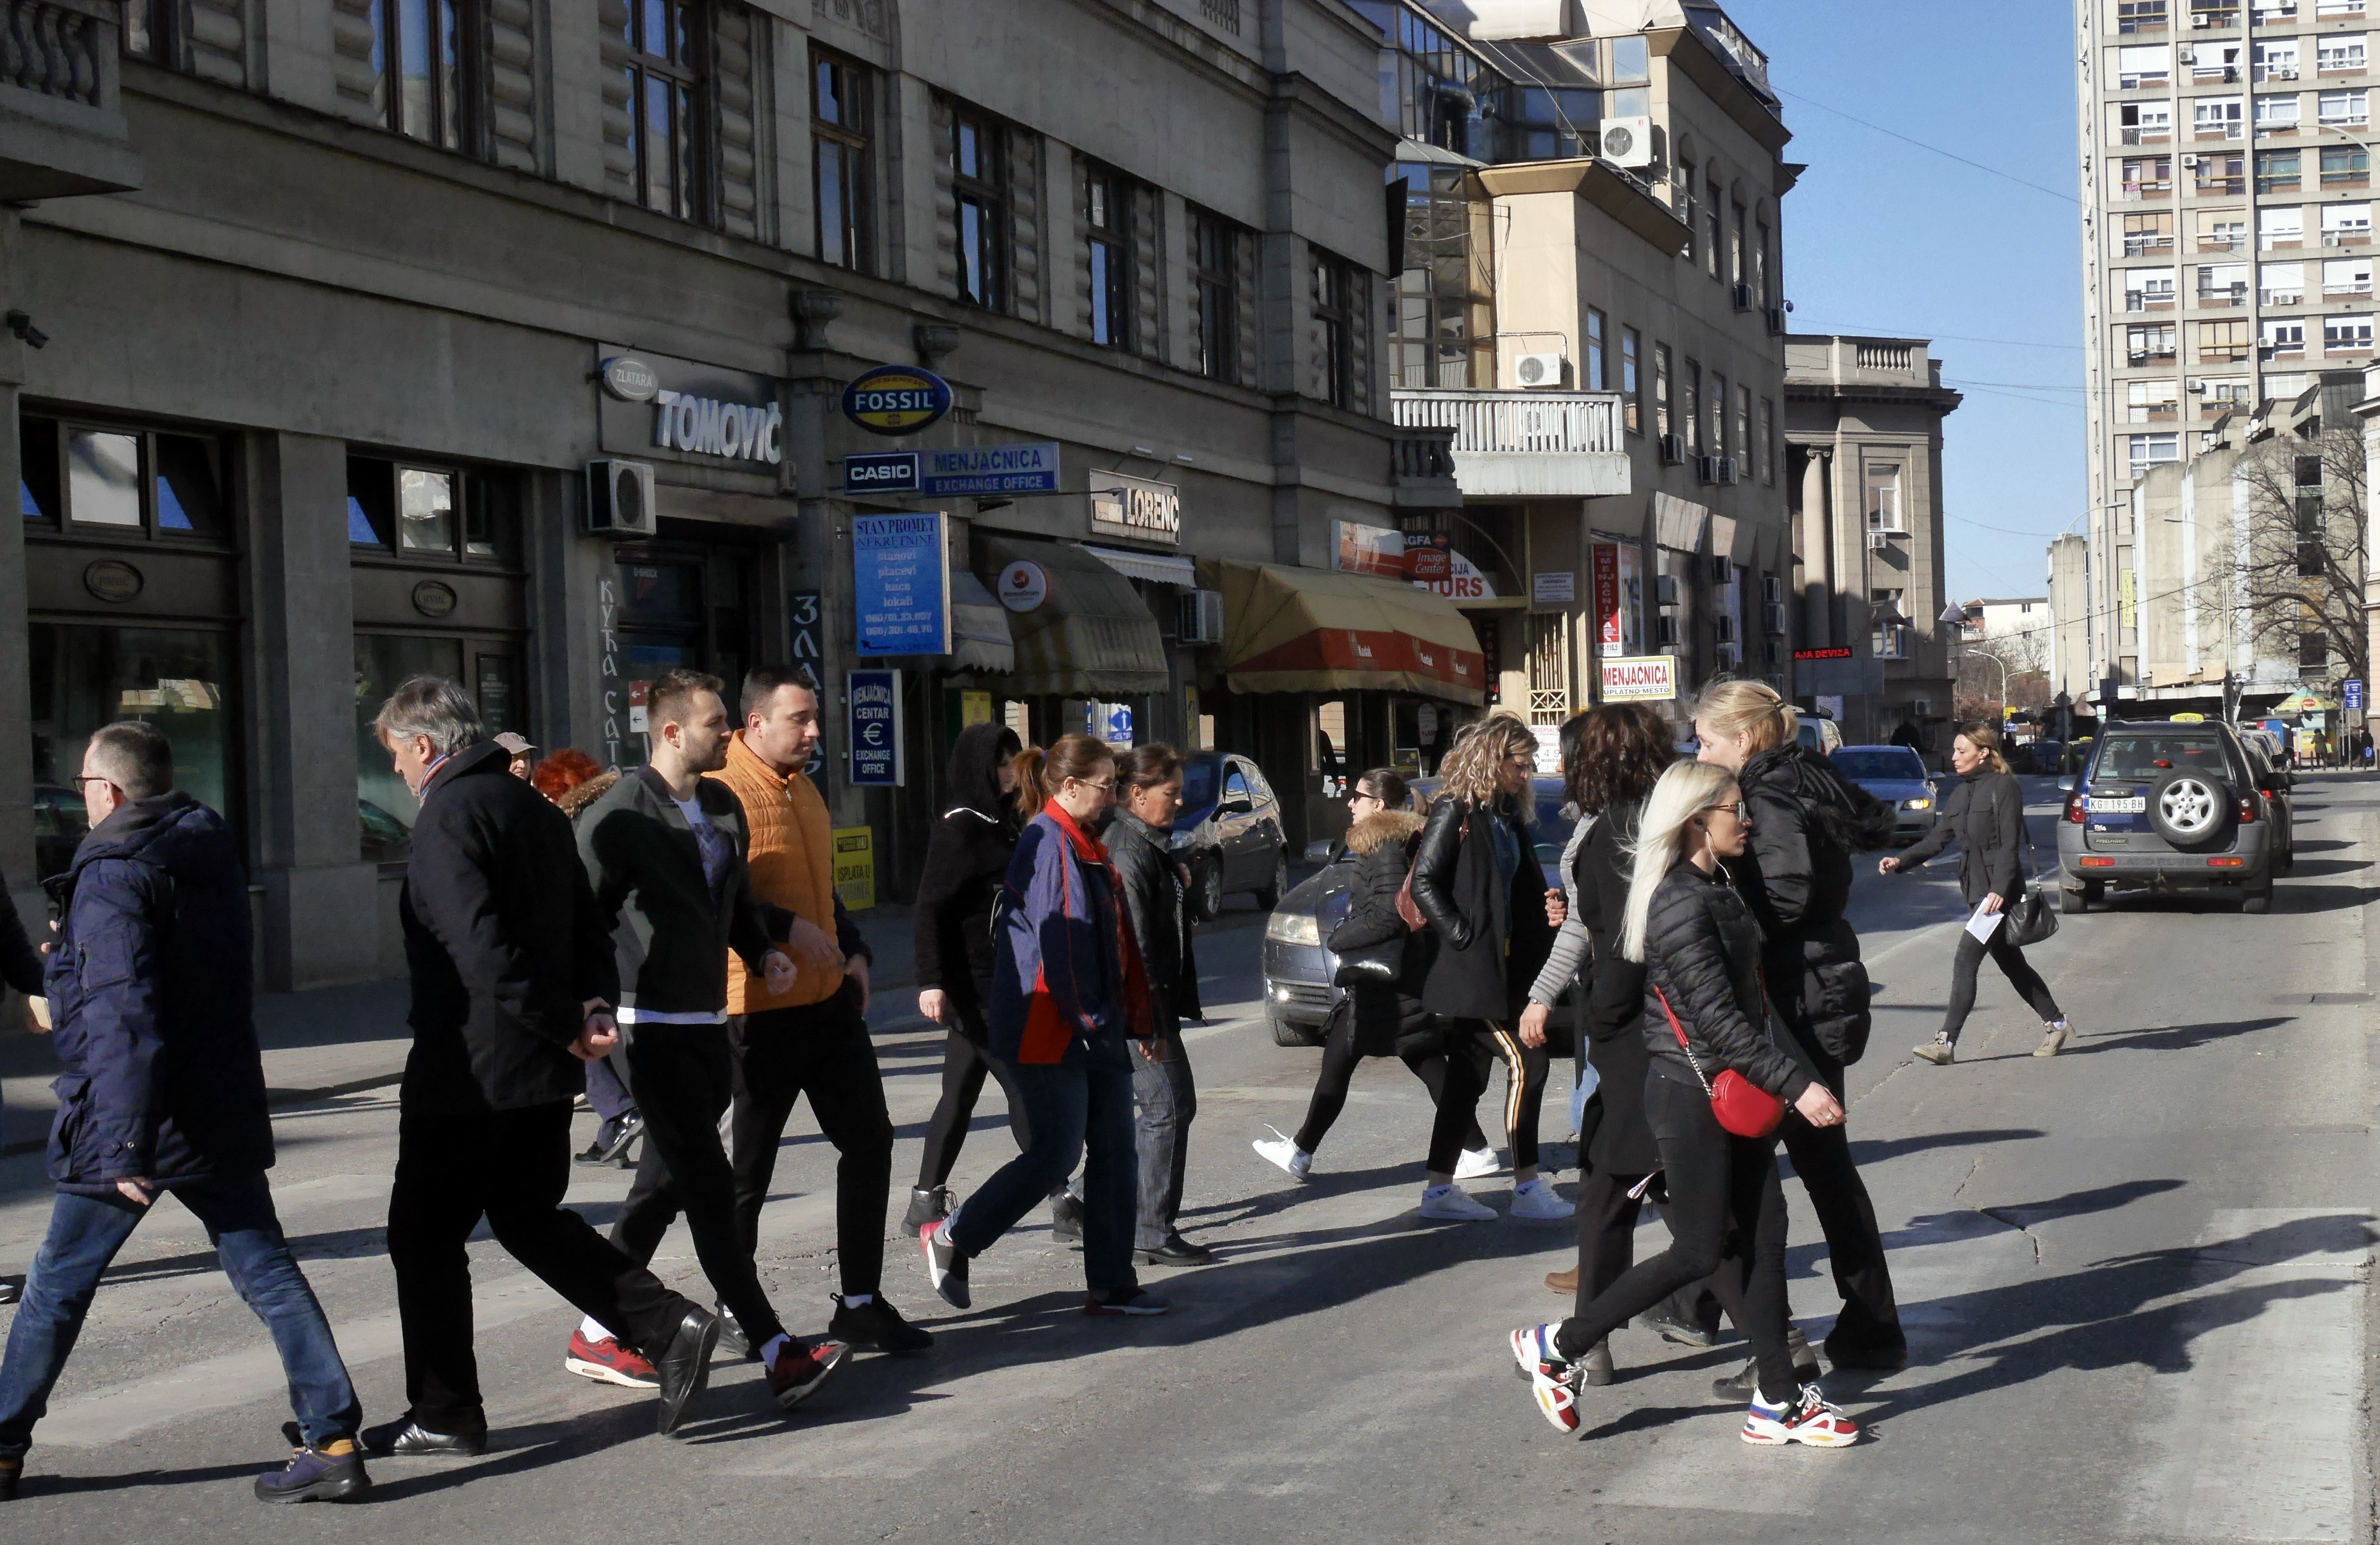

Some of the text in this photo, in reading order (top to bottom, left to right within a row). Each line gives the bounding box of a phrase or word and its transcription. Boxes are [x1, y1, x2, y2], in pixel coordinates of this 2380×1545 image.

[616, 369, 652, 387] ZLATARA
[855, 391, 934, 410] FOSSIL
[851, 465, 911, 481] CASIO
[935, 475, 1043, 492] EXCHANGE OFFICE
[1127, 487, 1180, 532] LORENC
[857, 517, 935, 535] STAN PROMET
[857, 534, 935, 548] NEKRETNINE
[877, 549, 917, 561] stanovi
[1417, 552, 1446, 565] Image
[878, 565, 917, 579] placevi
[1415, 563, 1445, 574] Center
[884, 596, 914, 607] lokali
[1794, 648, 1851, 660] AJA DEVIZA
[1603, 663, 1668, 686] MENJAČNICA
[856, 707, 889, 719] CENTAR
[856, 750, 891, 761] EXCHANGE
[862, 763, 885, 774] OFFICE
[2091, 799, 2143, 809] KG 195 BH
[838, 865, 864, 882] ISPLATA
